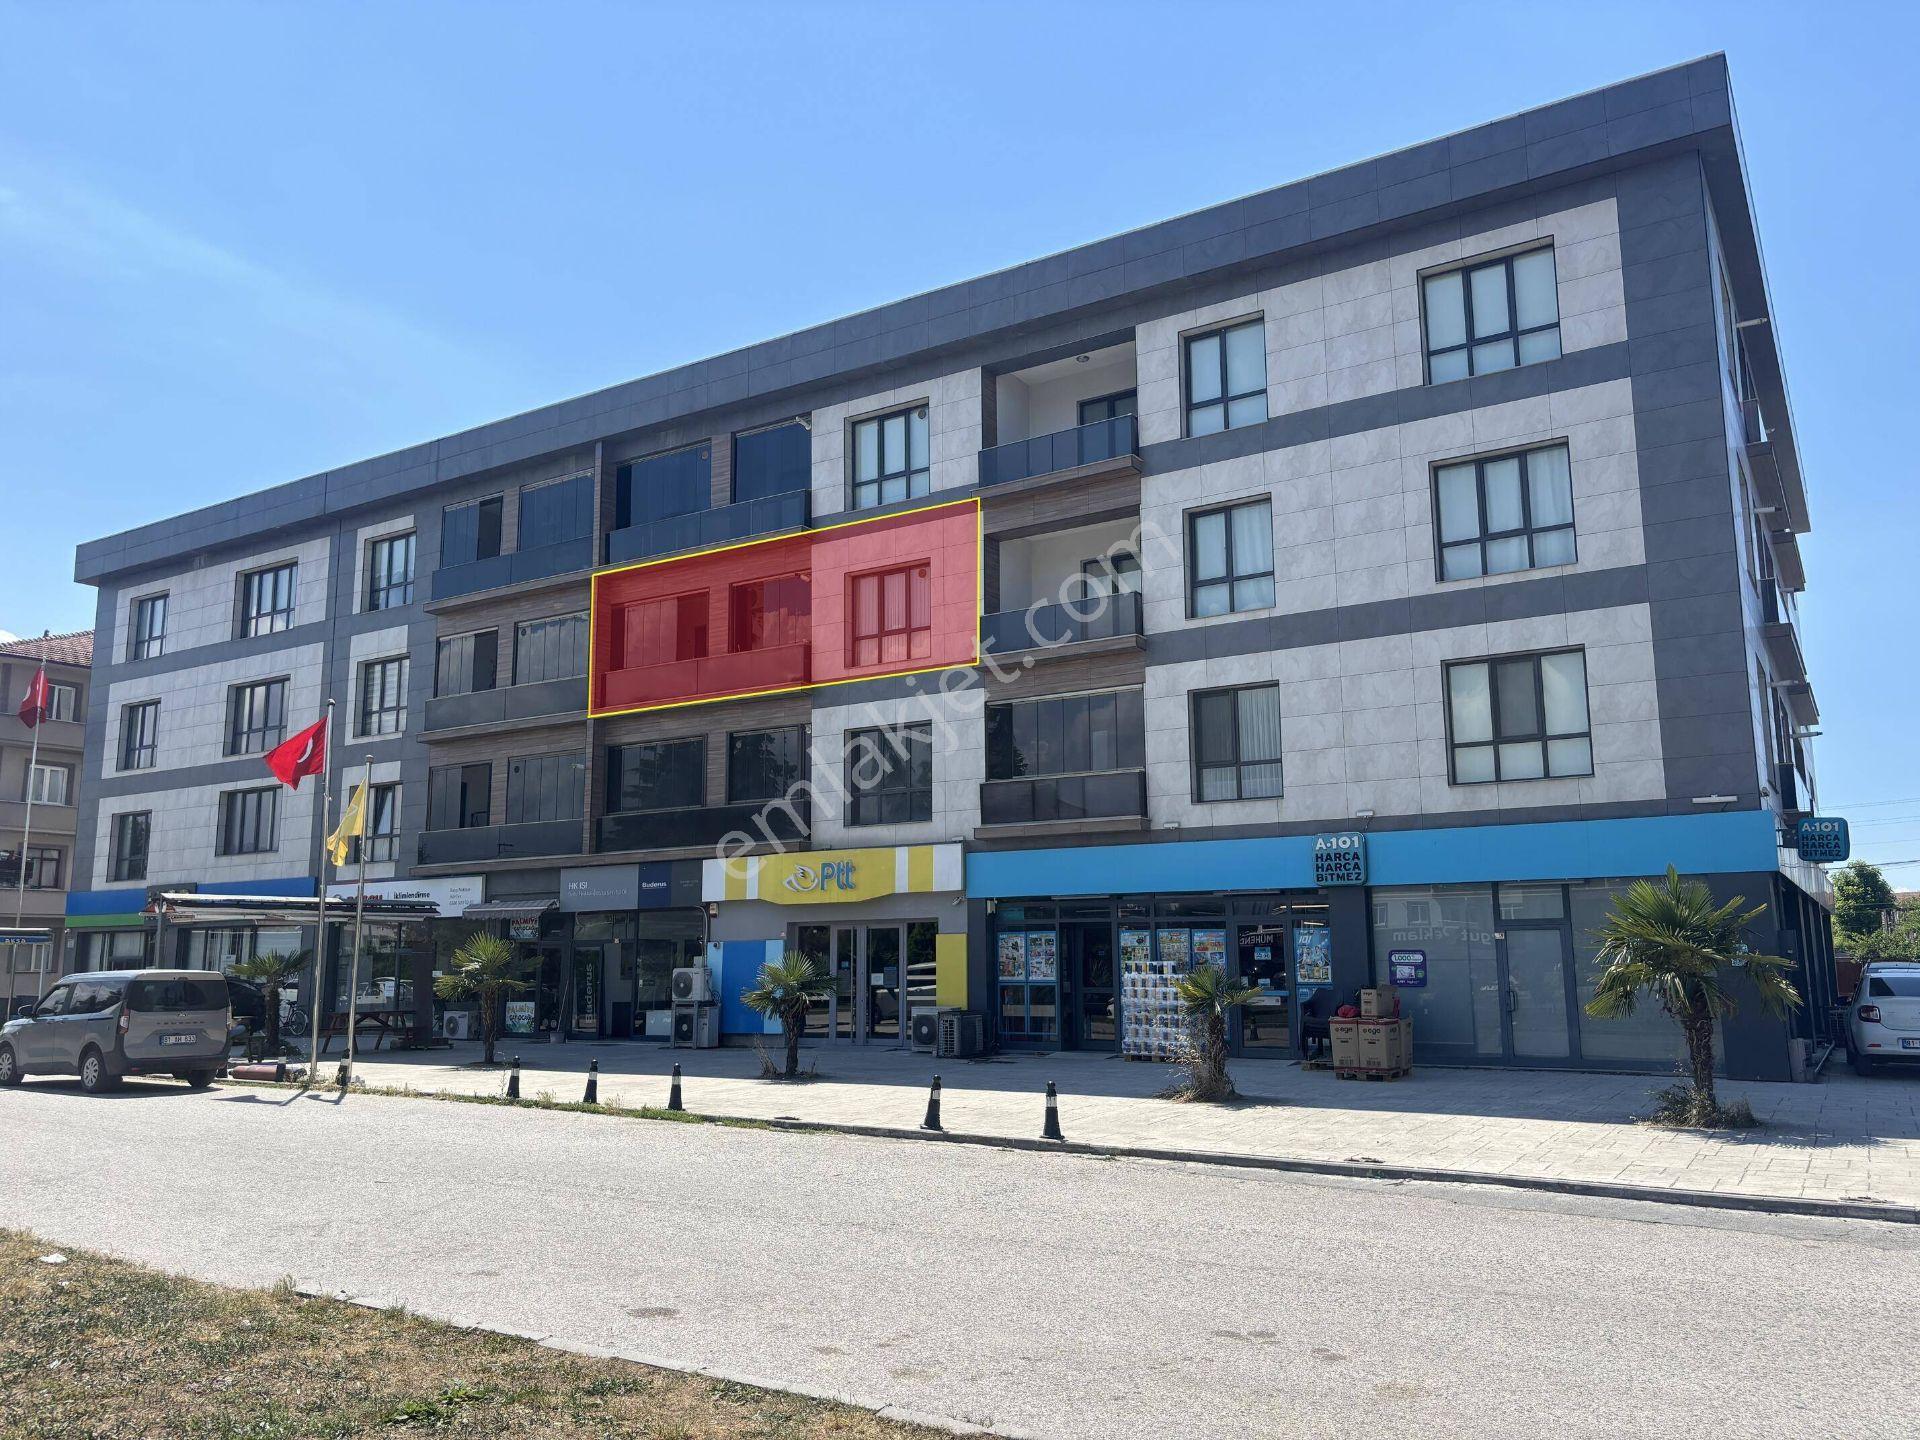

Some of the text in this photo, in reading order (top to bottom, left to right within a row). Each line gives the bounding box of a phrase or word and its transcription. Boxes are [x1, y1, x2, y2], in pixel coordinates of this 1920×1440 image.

[1315, 852, 1361, 862] HARCA
[1316, 862, 1361, 872] HARCA
[820, 861, 857, 891] Ptt
[585, 962, 593, 1024] Buderus
